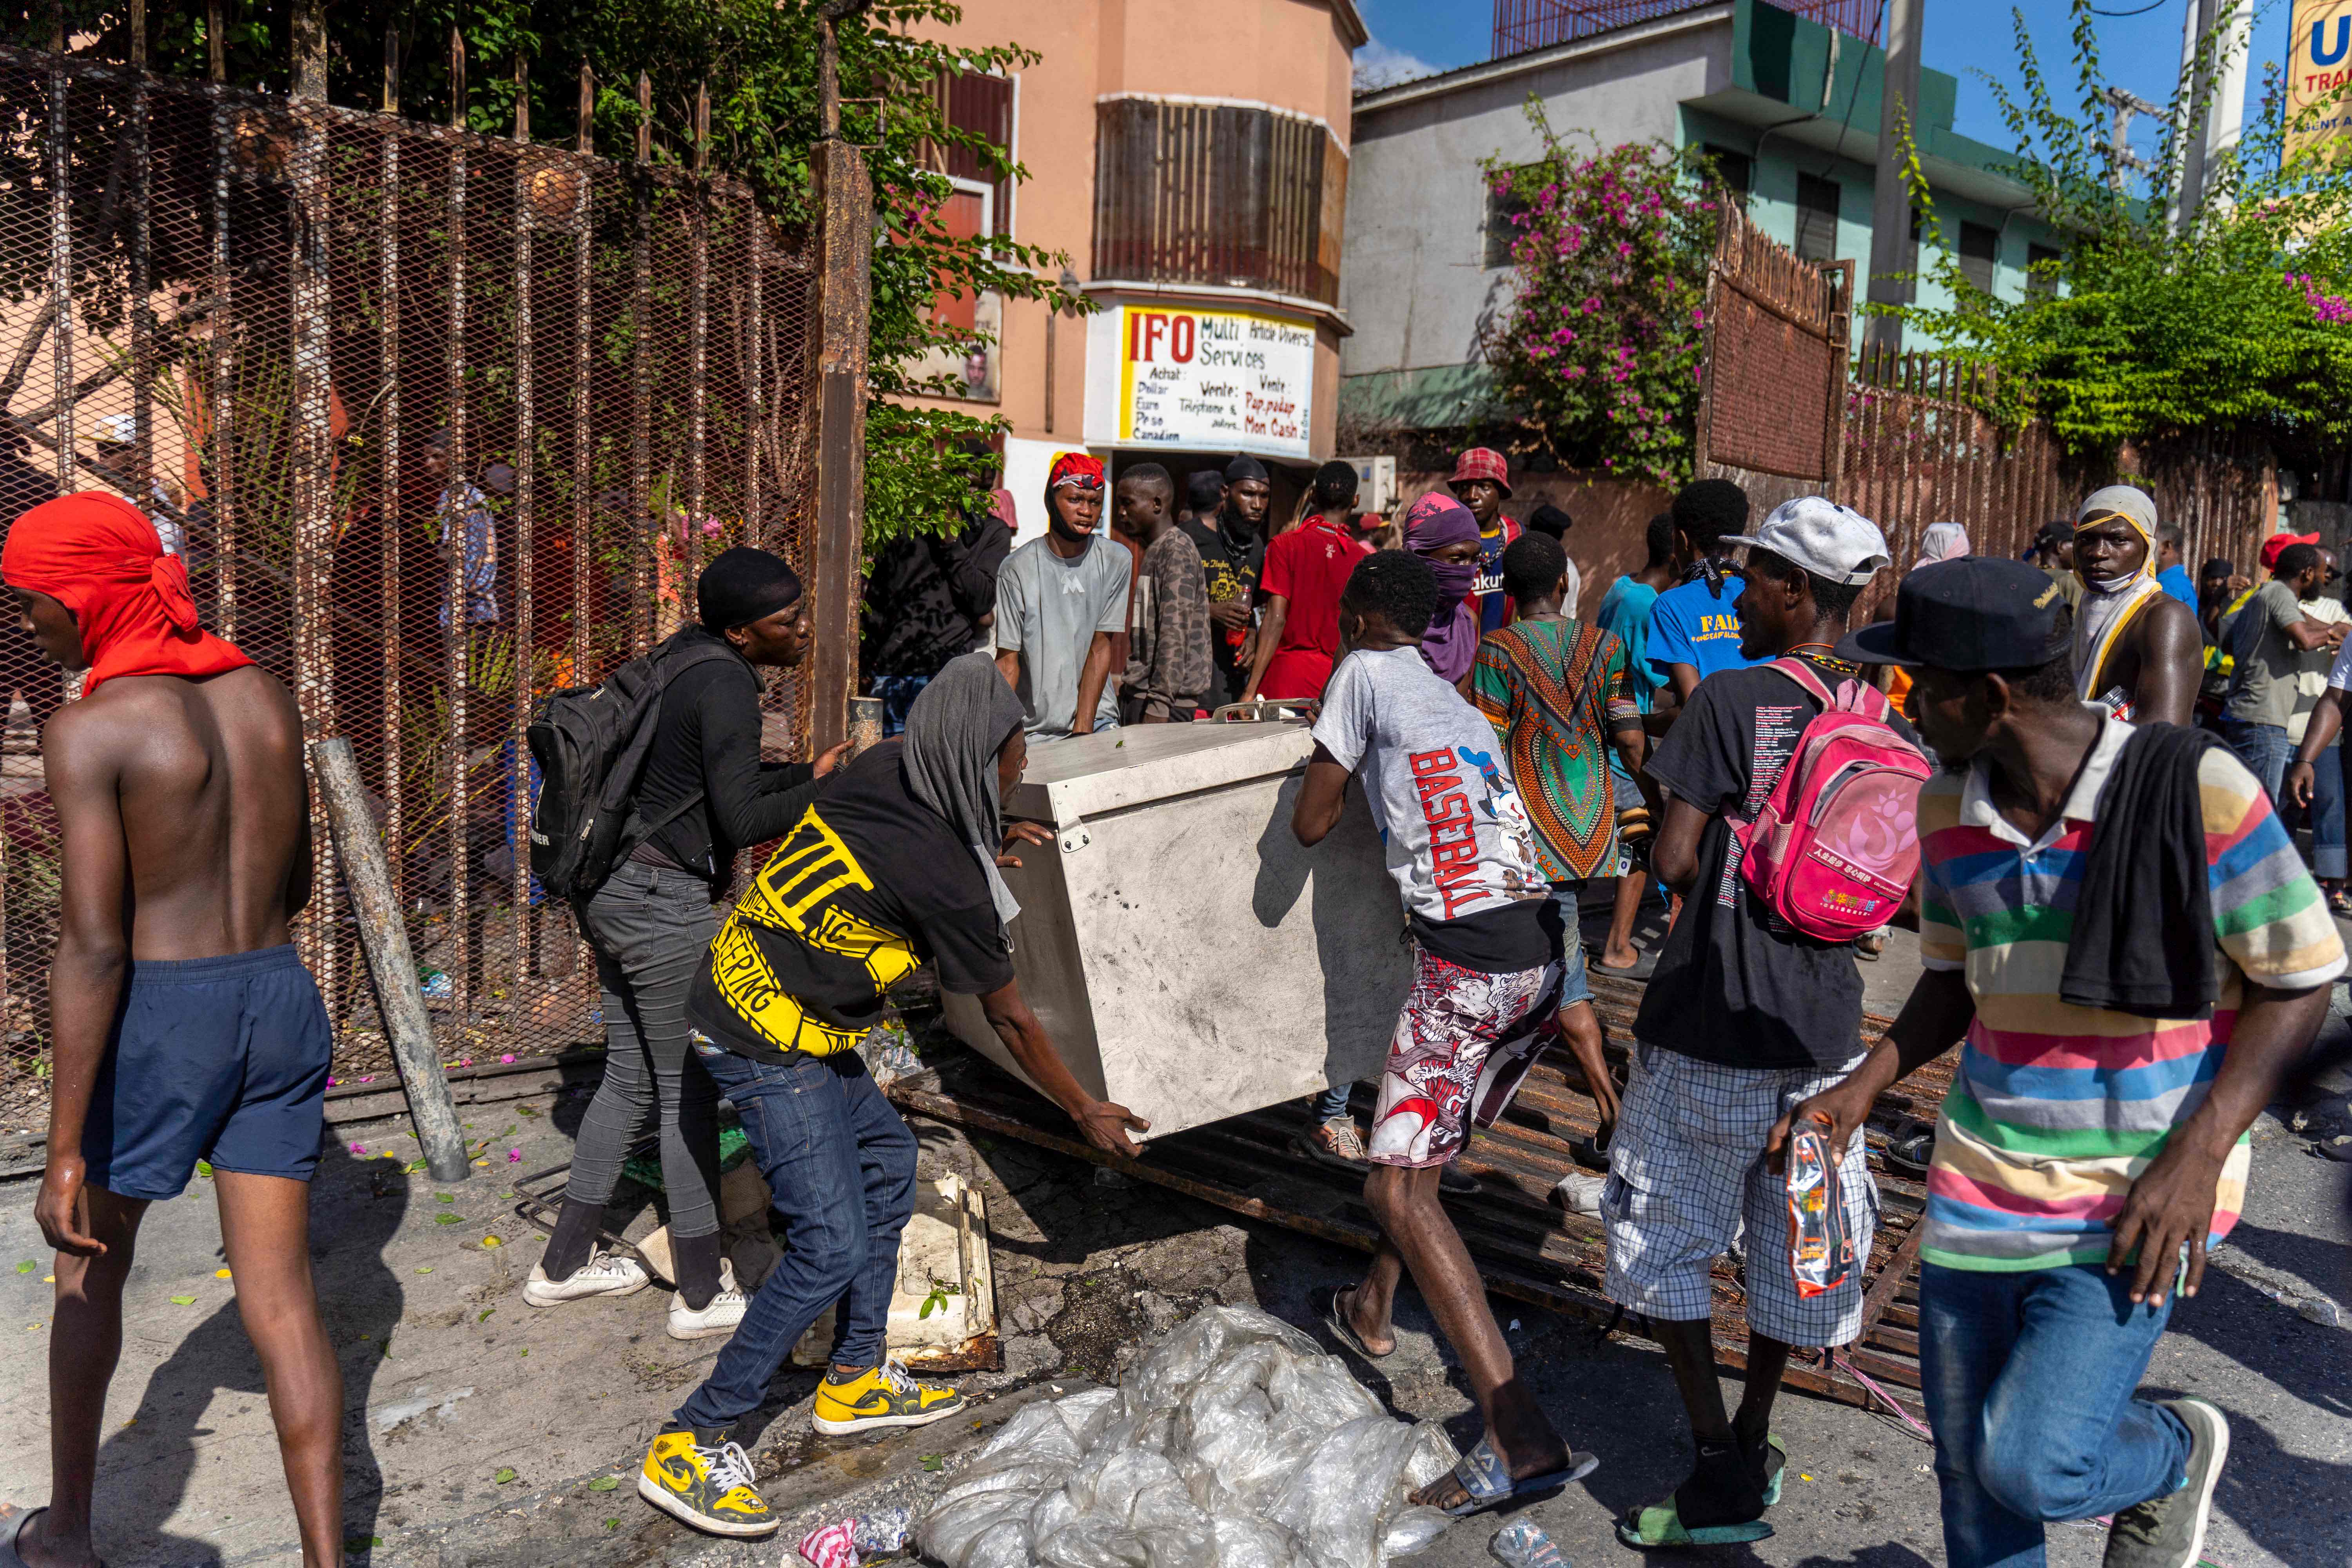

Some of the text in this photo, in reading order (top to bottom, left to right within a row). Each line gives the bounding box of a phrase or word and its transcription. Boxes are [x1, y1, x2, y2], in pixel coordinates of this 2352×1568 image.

[1129, 312, 1195, 363] IFO
[1200, 317, 1239, 340] Multi
[1200, 341, 1266, 369] Services
[1138, 381, 1169, 394] Dollar
[1136, 396, 1159, 410] Euro
[1133, 427, 1180, 441] Canadien
[1244, 414, 1298, 437] Mon Cash
[1471, 572, 1504, 590] akut
[1408, 747, 1490, 920] BASEBALL
